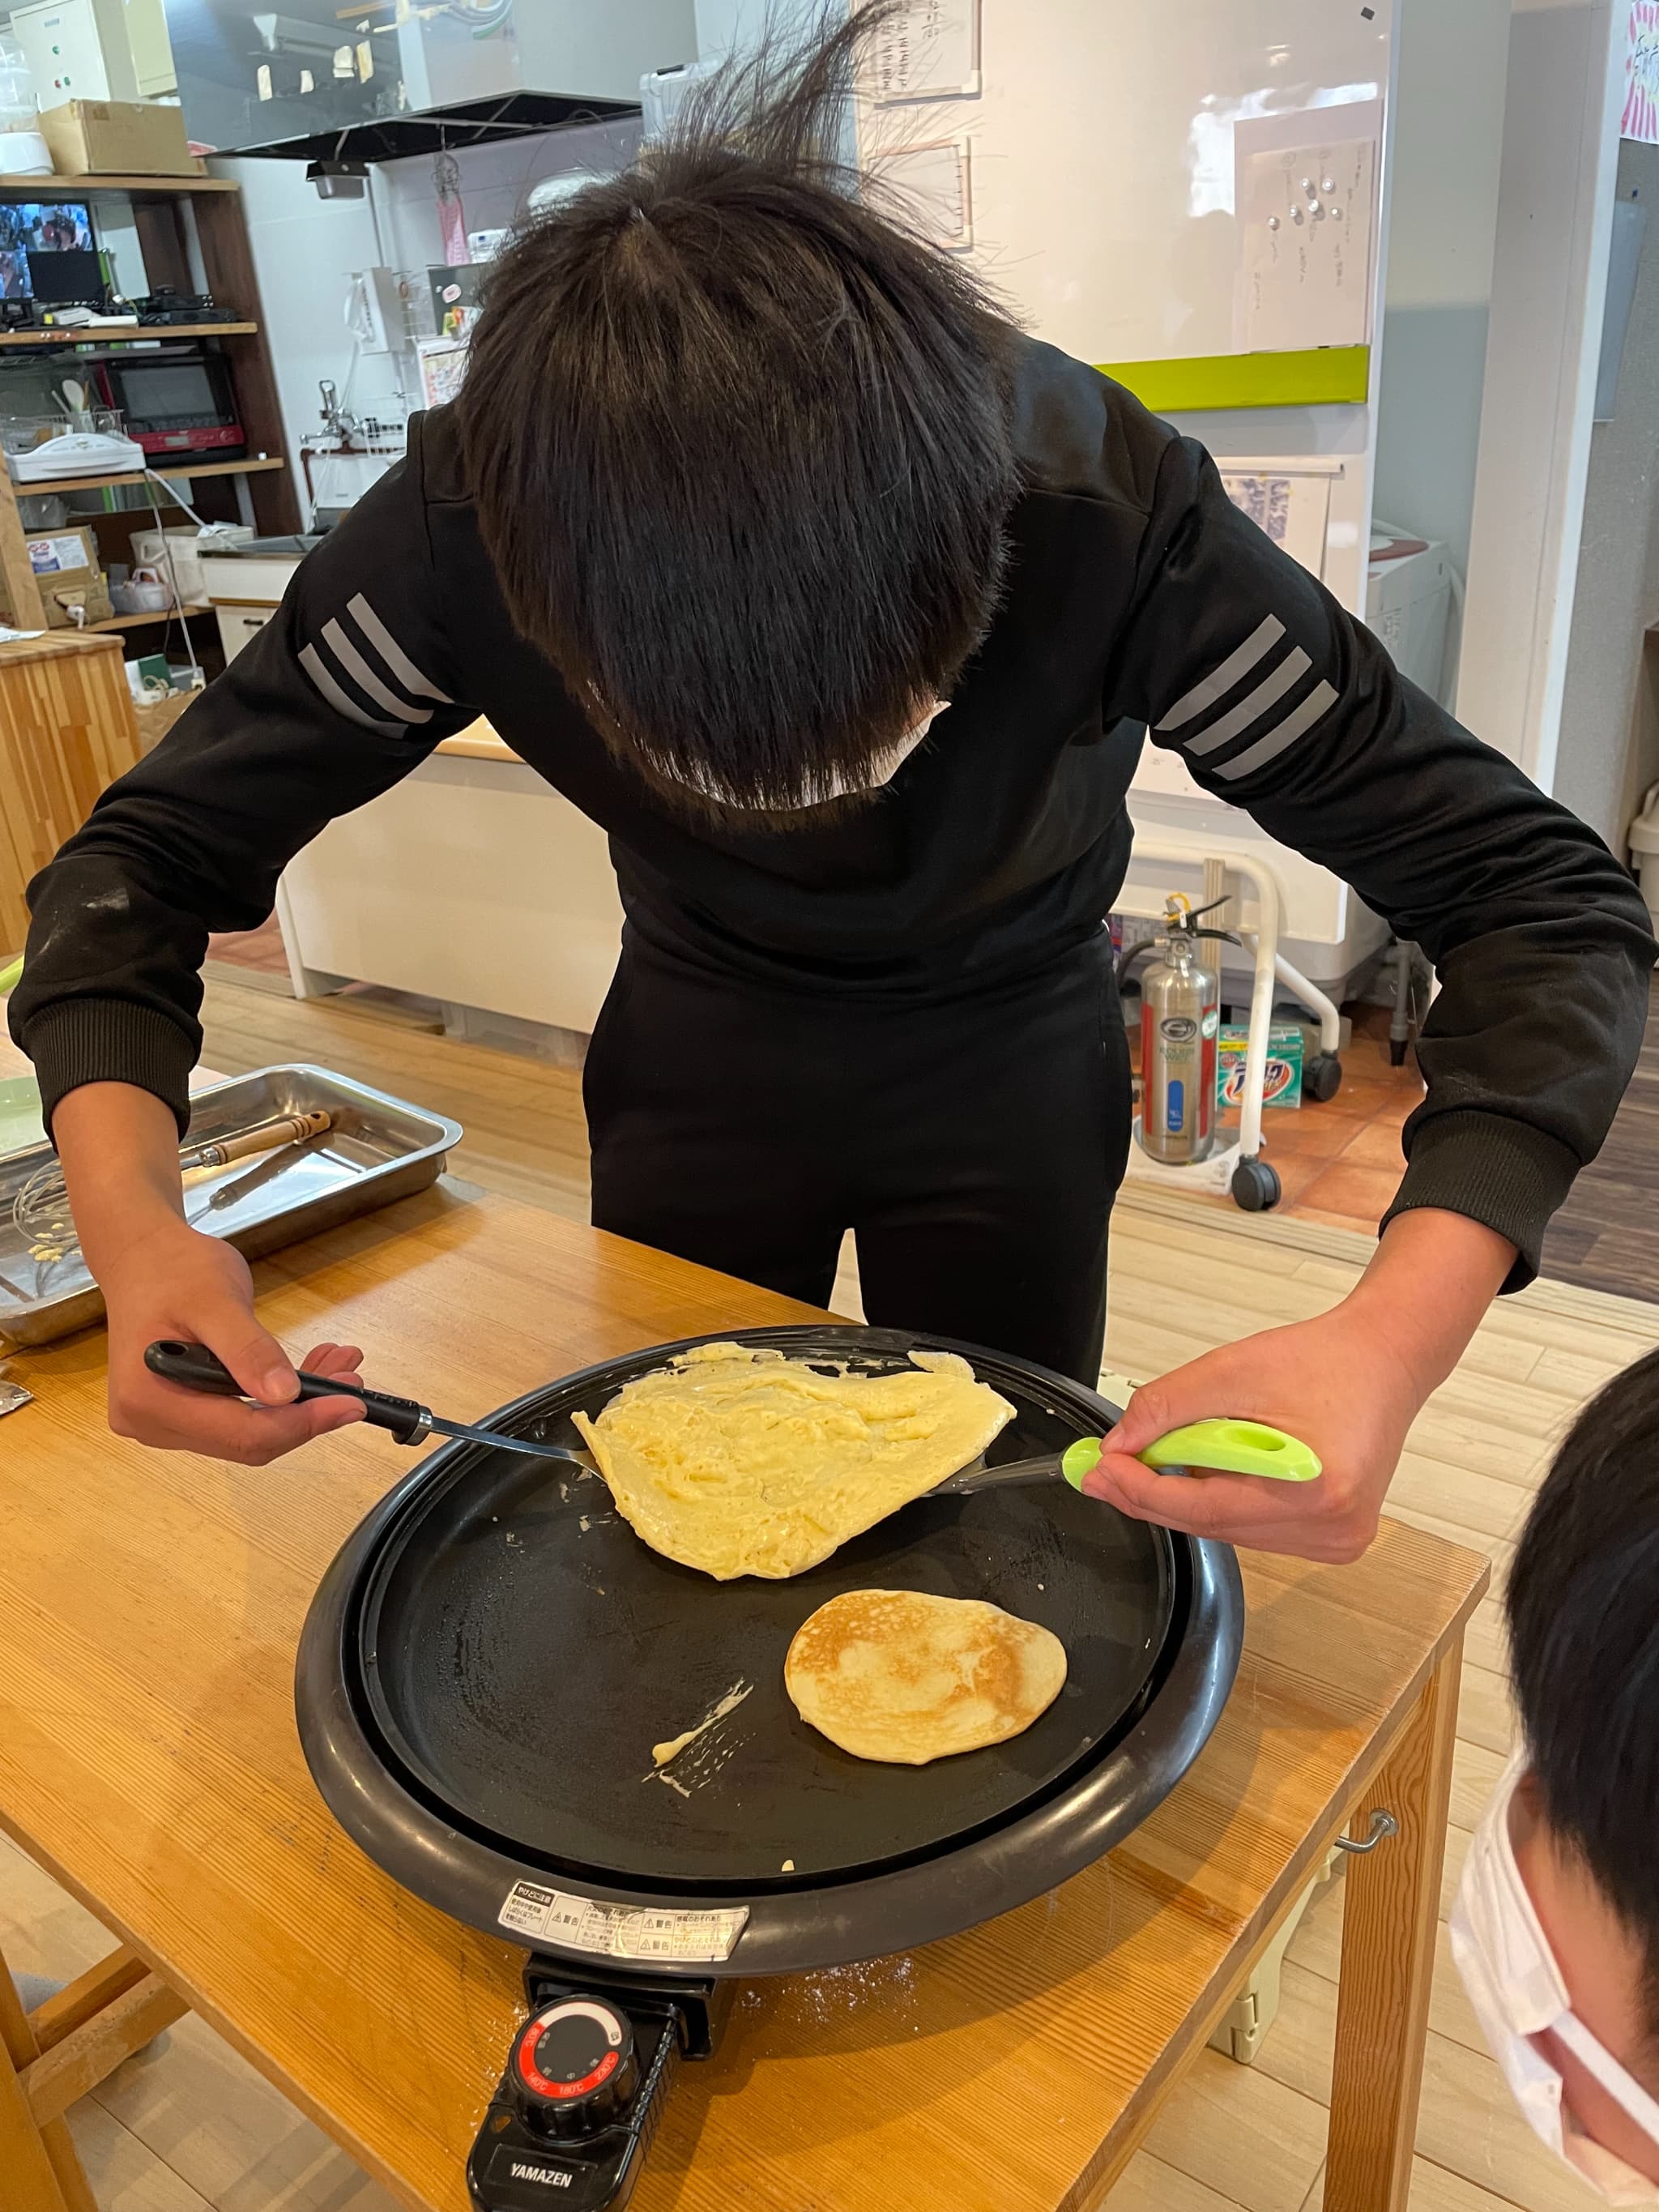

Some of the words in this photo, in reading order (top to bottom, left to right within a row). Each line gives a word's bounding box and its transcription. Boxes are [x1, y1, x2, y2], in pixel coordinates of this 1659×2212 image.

[563, 1915, 579, 1926] 警告
[656, 1919, 672, 1929] 警告
[653, 1941, 669, 1950] 警告
[510, 2163, 573, 2189] YAMAZEN
